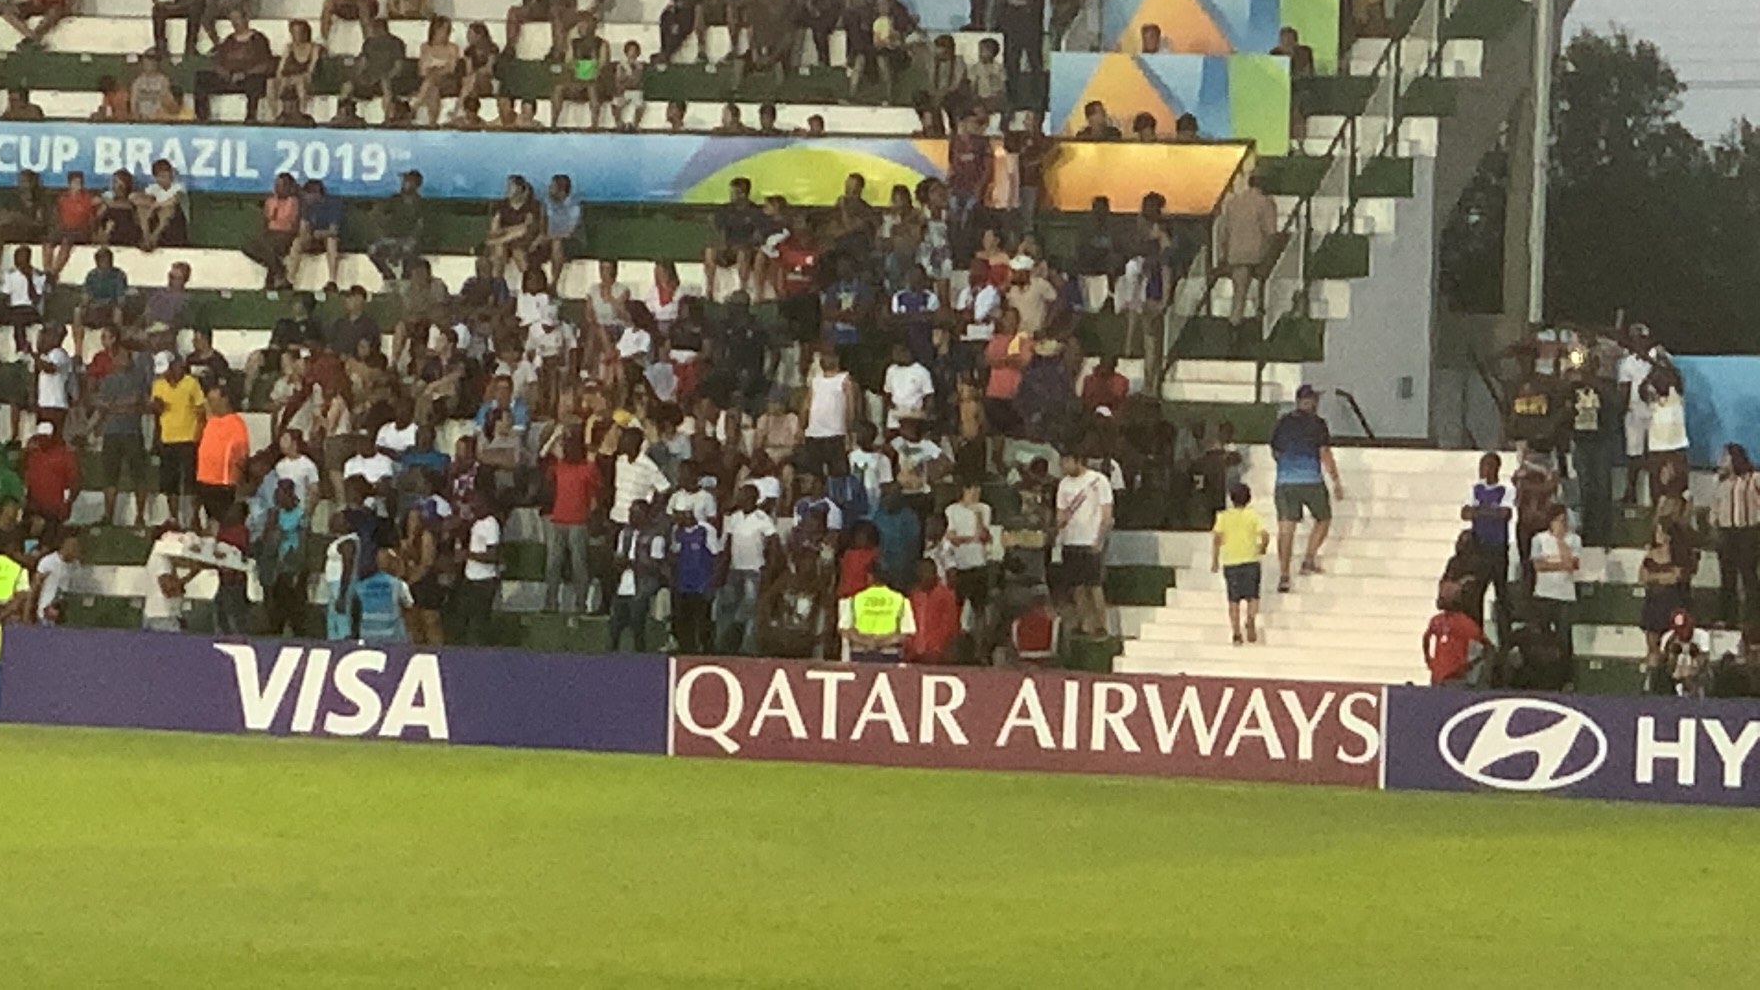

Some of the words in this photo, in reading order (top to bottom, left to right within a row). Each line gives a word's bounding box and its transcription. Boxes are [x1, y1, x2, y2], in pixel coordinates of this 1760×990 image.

[93, 135, 259, 179] BRAZIL
[274, 139, 388, 182] 2019
[212, 642, 450, 740] VISA
[675, 665, 970, 754] QATAR
[995, 677, 1380, 764] AIRWAYS
[1635, 716, 1760, 788] HY
